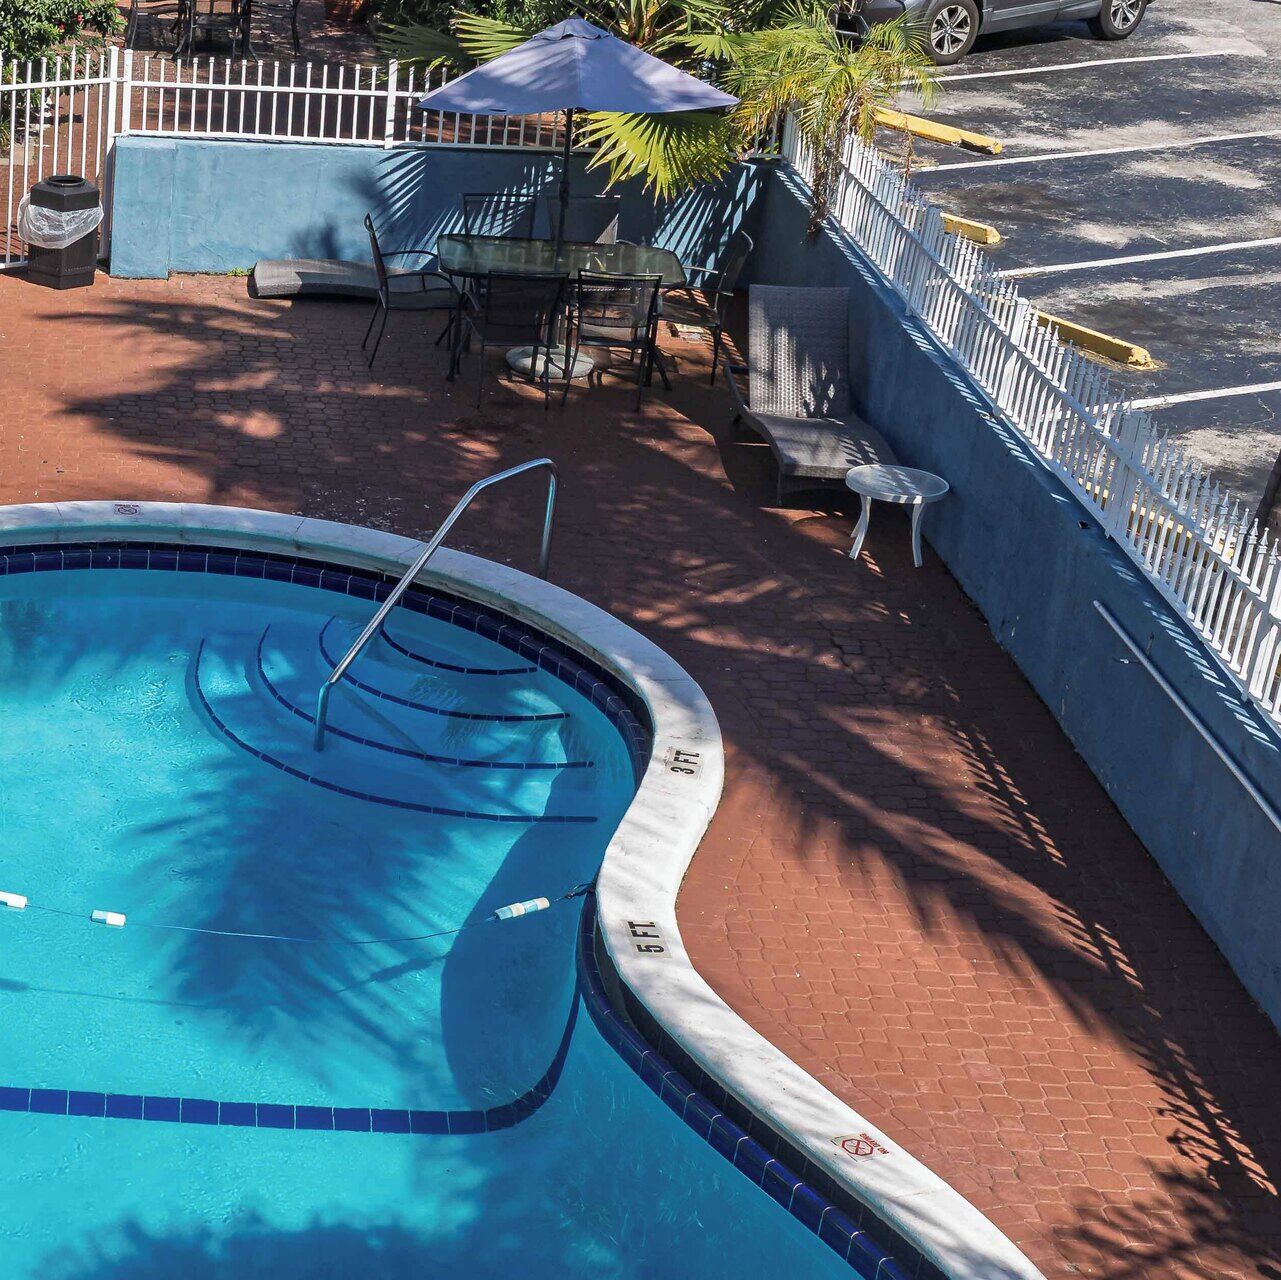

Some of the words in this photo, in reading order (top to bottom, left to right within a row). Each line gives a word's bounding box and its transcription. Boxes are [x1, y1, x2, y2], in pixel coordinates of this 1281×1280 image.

[670, 766, 696, 775] 3
[628, 920, 660, 940] FT.
[636, 944, 665, 954] 5
